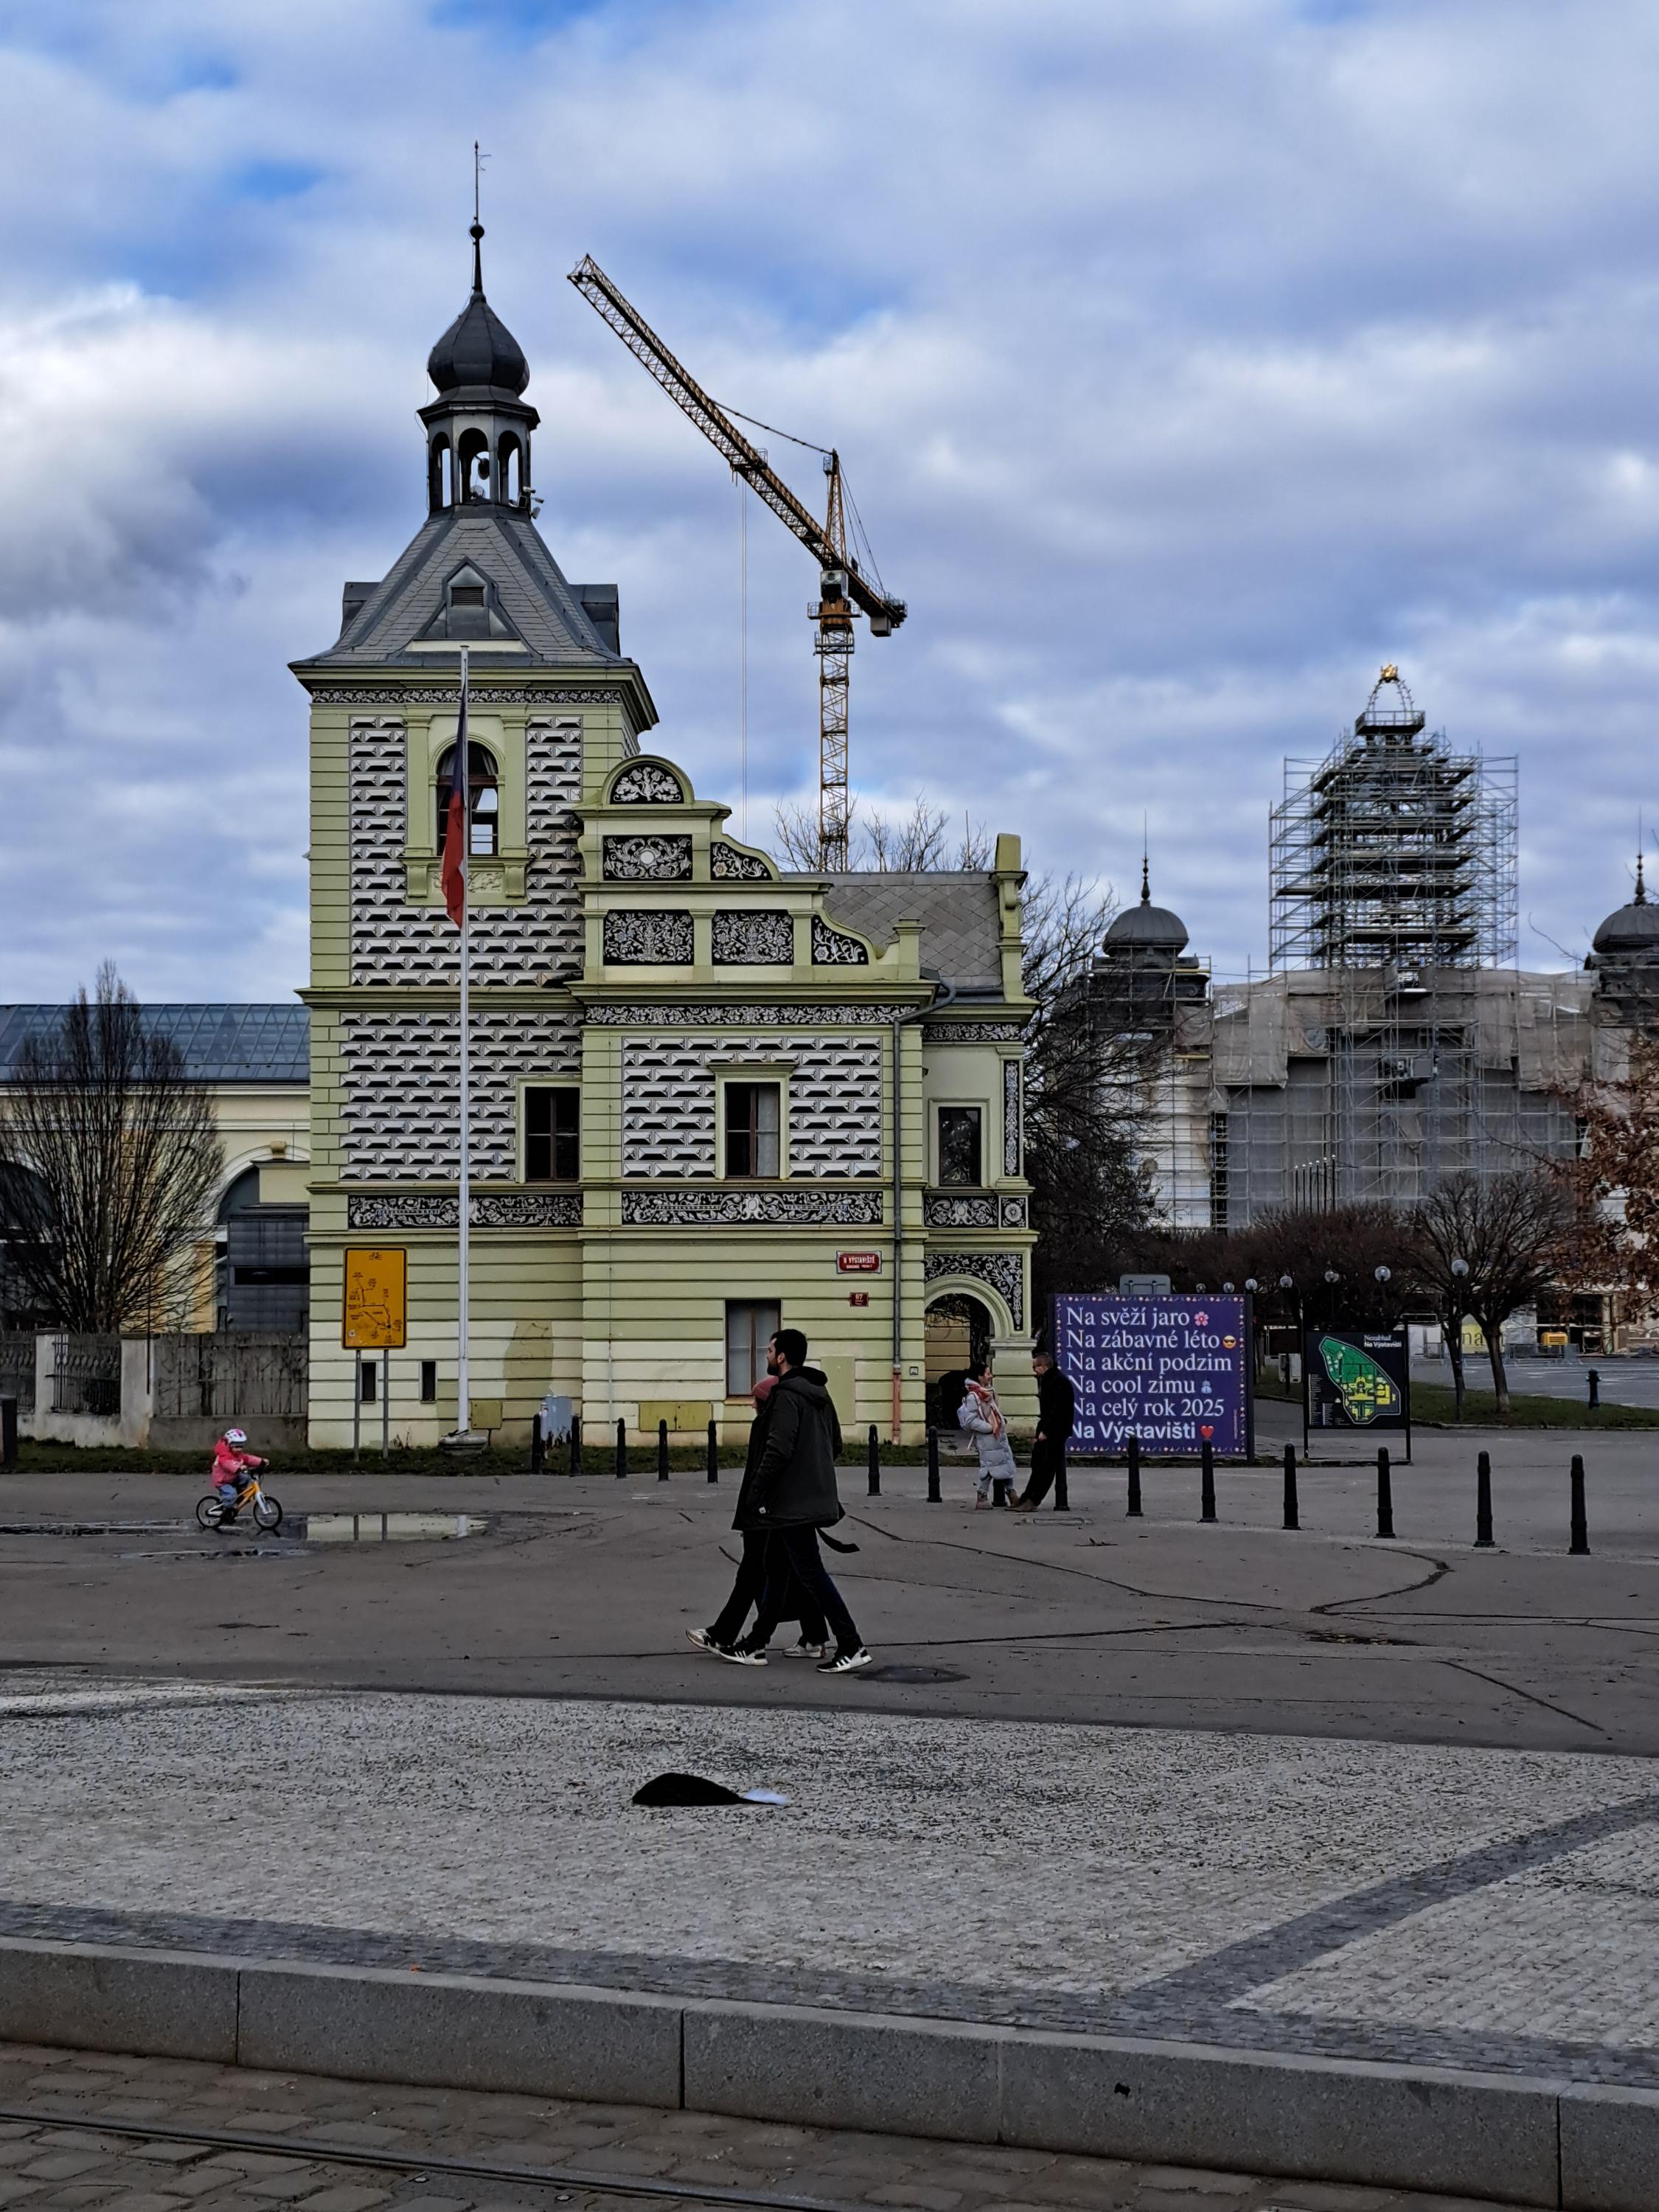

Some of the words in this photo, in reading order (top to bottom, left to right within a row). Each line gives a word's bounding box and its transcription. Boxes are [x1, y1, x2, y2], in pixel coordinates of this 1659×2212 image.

[1066, 1307, 1096, 1326] Na
[1101, 1307, 1146, 1326] svěží
[1152, 1307, 1190, 1330] jaro
[1066, 1329, 1096, 1349] Na
[1101, 1329, 1178, 1349] zábavné
[1184, 1329, 1220, 1349] léto
[1066, 1352, 1096, 1371] Na
[1101, 1352, 1154, 1371] akční
[1159, 1352, 1232, 1375] podzim
[1068, 1375, 1096, 1394] Na
[1102, 1375, 1142, 1394] cool
[1148, 1375, 1195, 1394] zimu
[1074, 1398, 1096, 1416] Na
[1102, 1398, 1138, 1420] celý
[1143, 1398, 1176, 1416] rok
[1180, 1399, 1224, 1416] 2025
[1072, 1422, 1095, 1439] Na
[1099, 1421, 1195, 1443] Výstavišti
